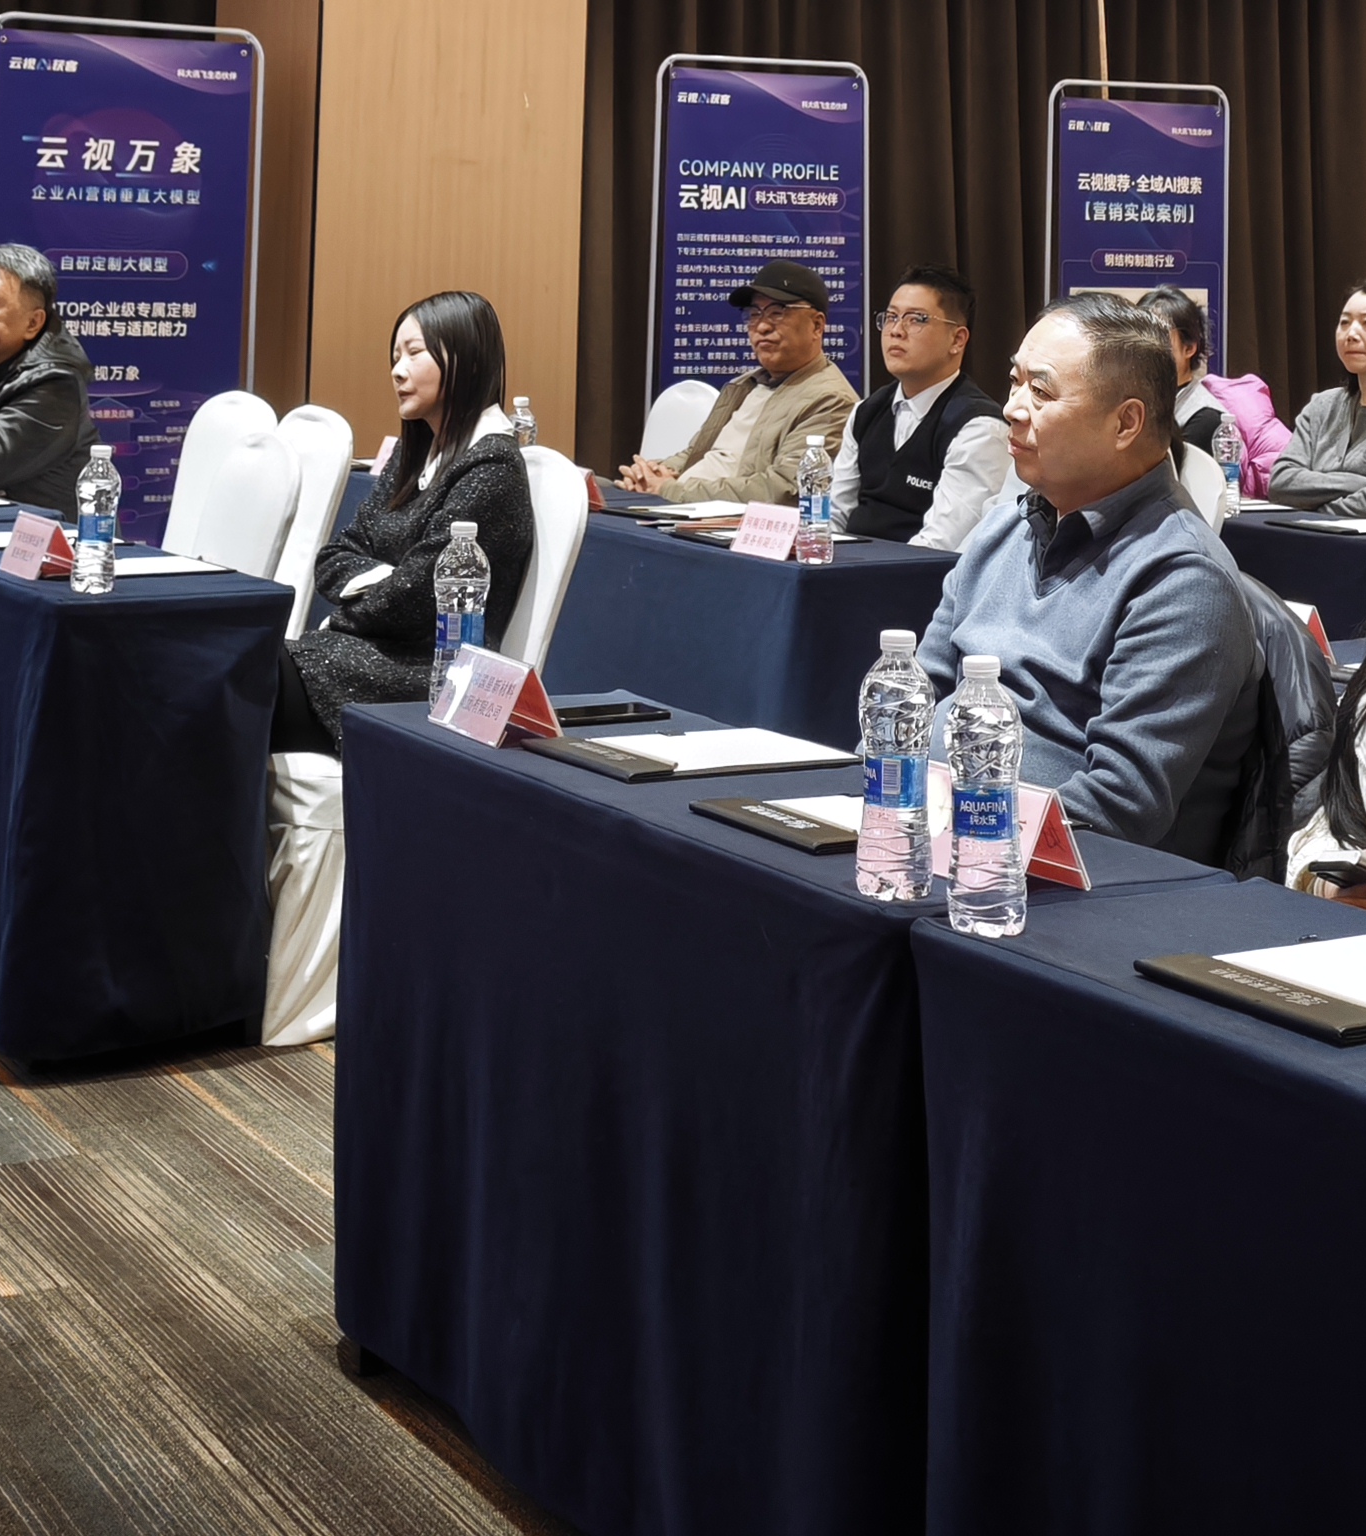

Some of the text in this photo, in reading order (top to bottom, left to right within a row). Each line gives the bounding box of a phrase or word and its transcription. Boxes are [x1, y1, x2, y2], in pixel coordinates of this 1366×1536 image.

[36, 136, 203, 174] 云视万象
[679, 159, 840, 181] COMPANY PROFILE
[31, 184, 202, 205] 企业AI营销垂直大模型
[678, 183, 747, 210] 云视AI
[755, 190, 839, 206] 科大讯飞生态伙伴
[1084, 200, 1195, 224] 【营销实战案例】
[60, 255, 169, 273] 自研定制大模型
[51, 301, 197, 319] TOP企业级专属定制
[63, 320, 188, 338] 型训练与适配能力
[94, 365, 140, 382] 视万象
[906, 474, 933, 491] POLICE
[959, 799, 1008, 815] AQUAFINA
